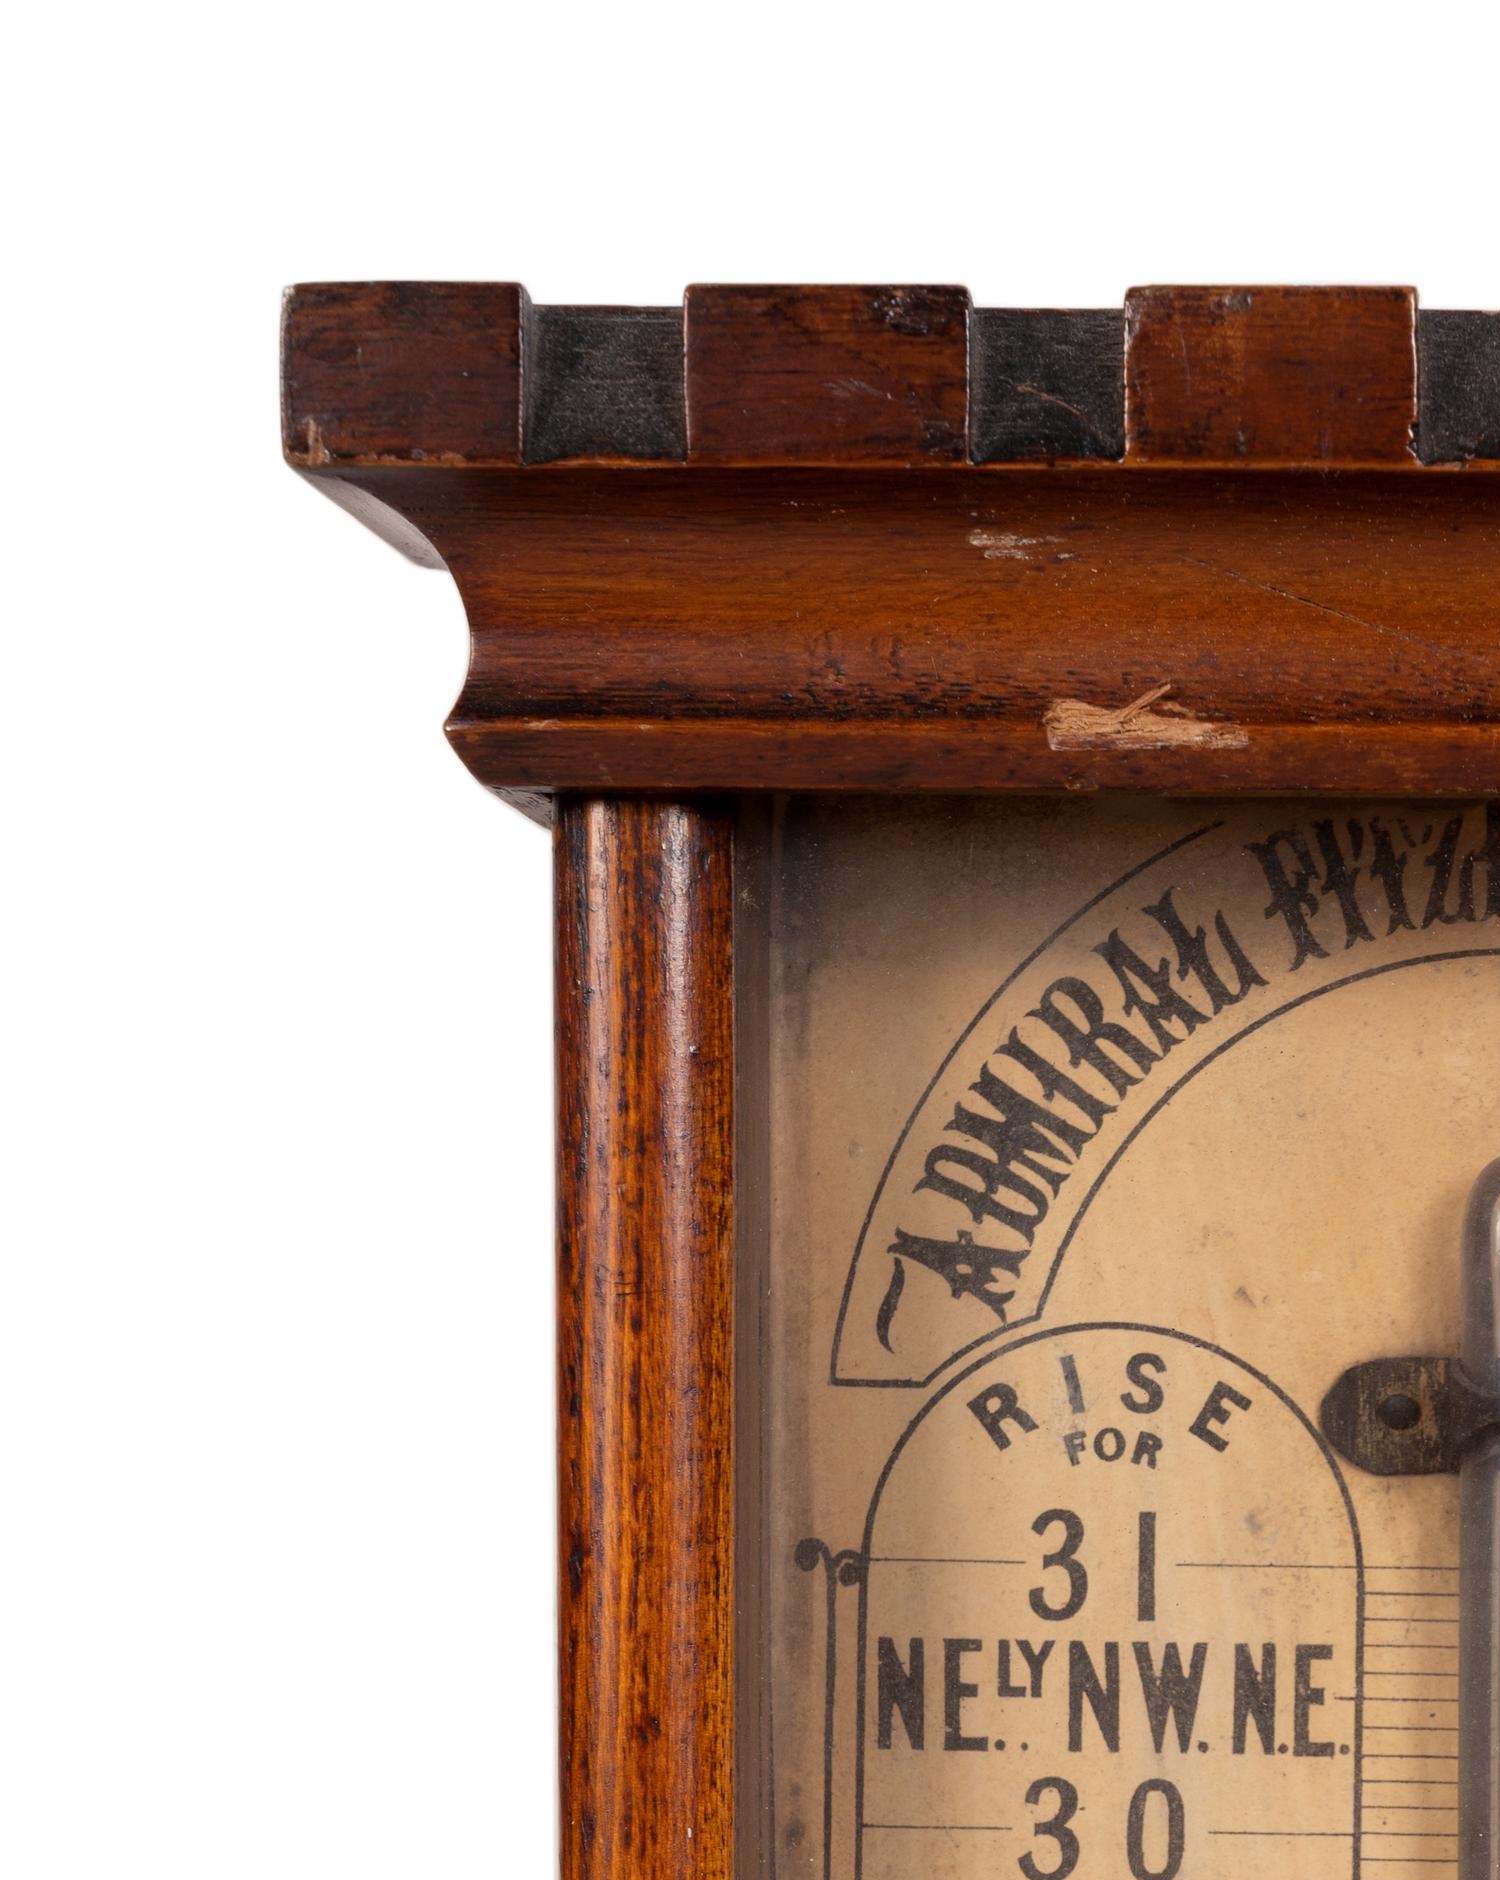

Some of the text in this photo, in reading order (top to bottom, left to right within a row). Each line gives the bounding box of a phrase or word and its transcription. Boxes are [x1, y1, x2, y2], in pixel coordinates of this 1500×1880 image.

[876, 888, 1269, 1353] ADMIRAL
[966, 1353, 1252, 1452] RISE
[1062, 1429, 1163, 1469] FOR
